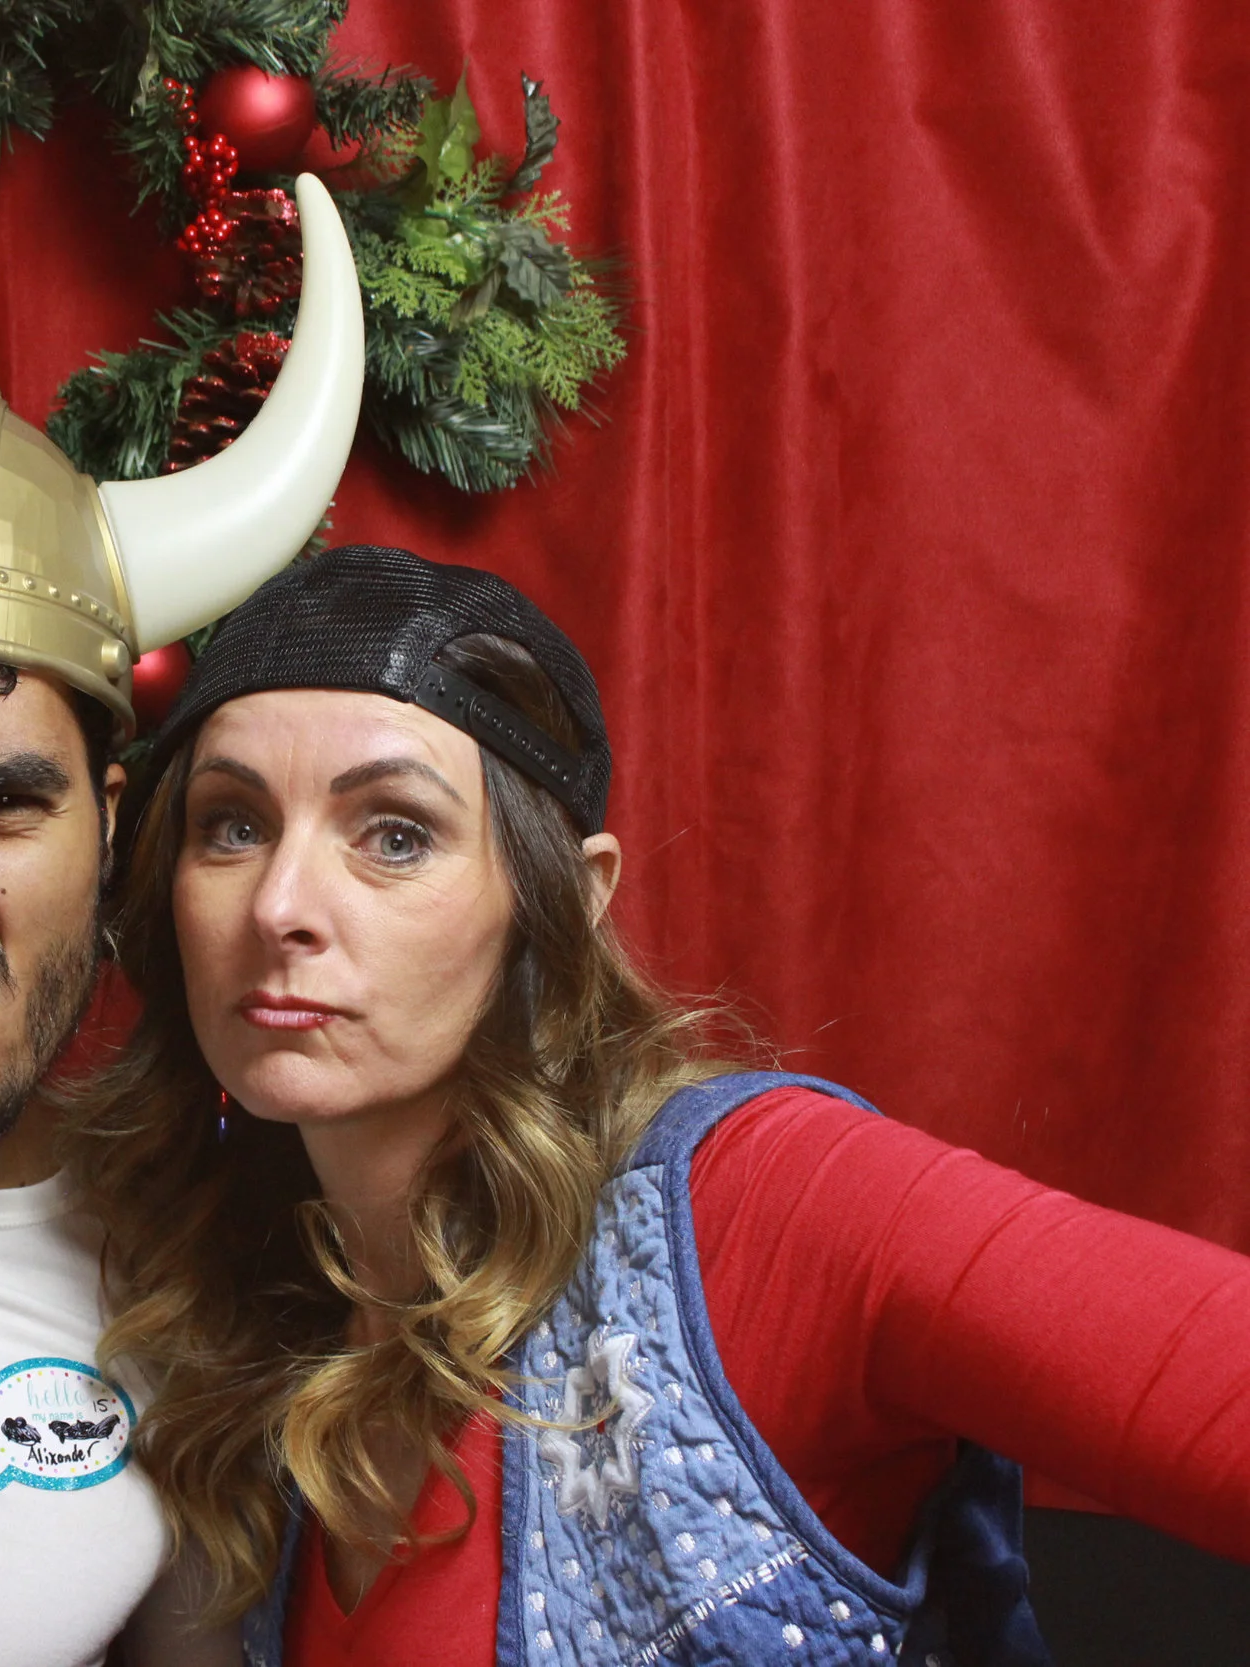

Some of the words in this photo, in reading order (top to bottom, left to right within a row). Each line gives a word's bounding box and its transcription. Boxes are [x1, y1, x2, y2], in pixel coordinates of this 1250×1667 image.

[27, 1380, 88, 1408] hello
[32, 1413, 46, 1423] my
[49, 1412, 74, 1421] name
[76, 1411, 84, 1420] is
